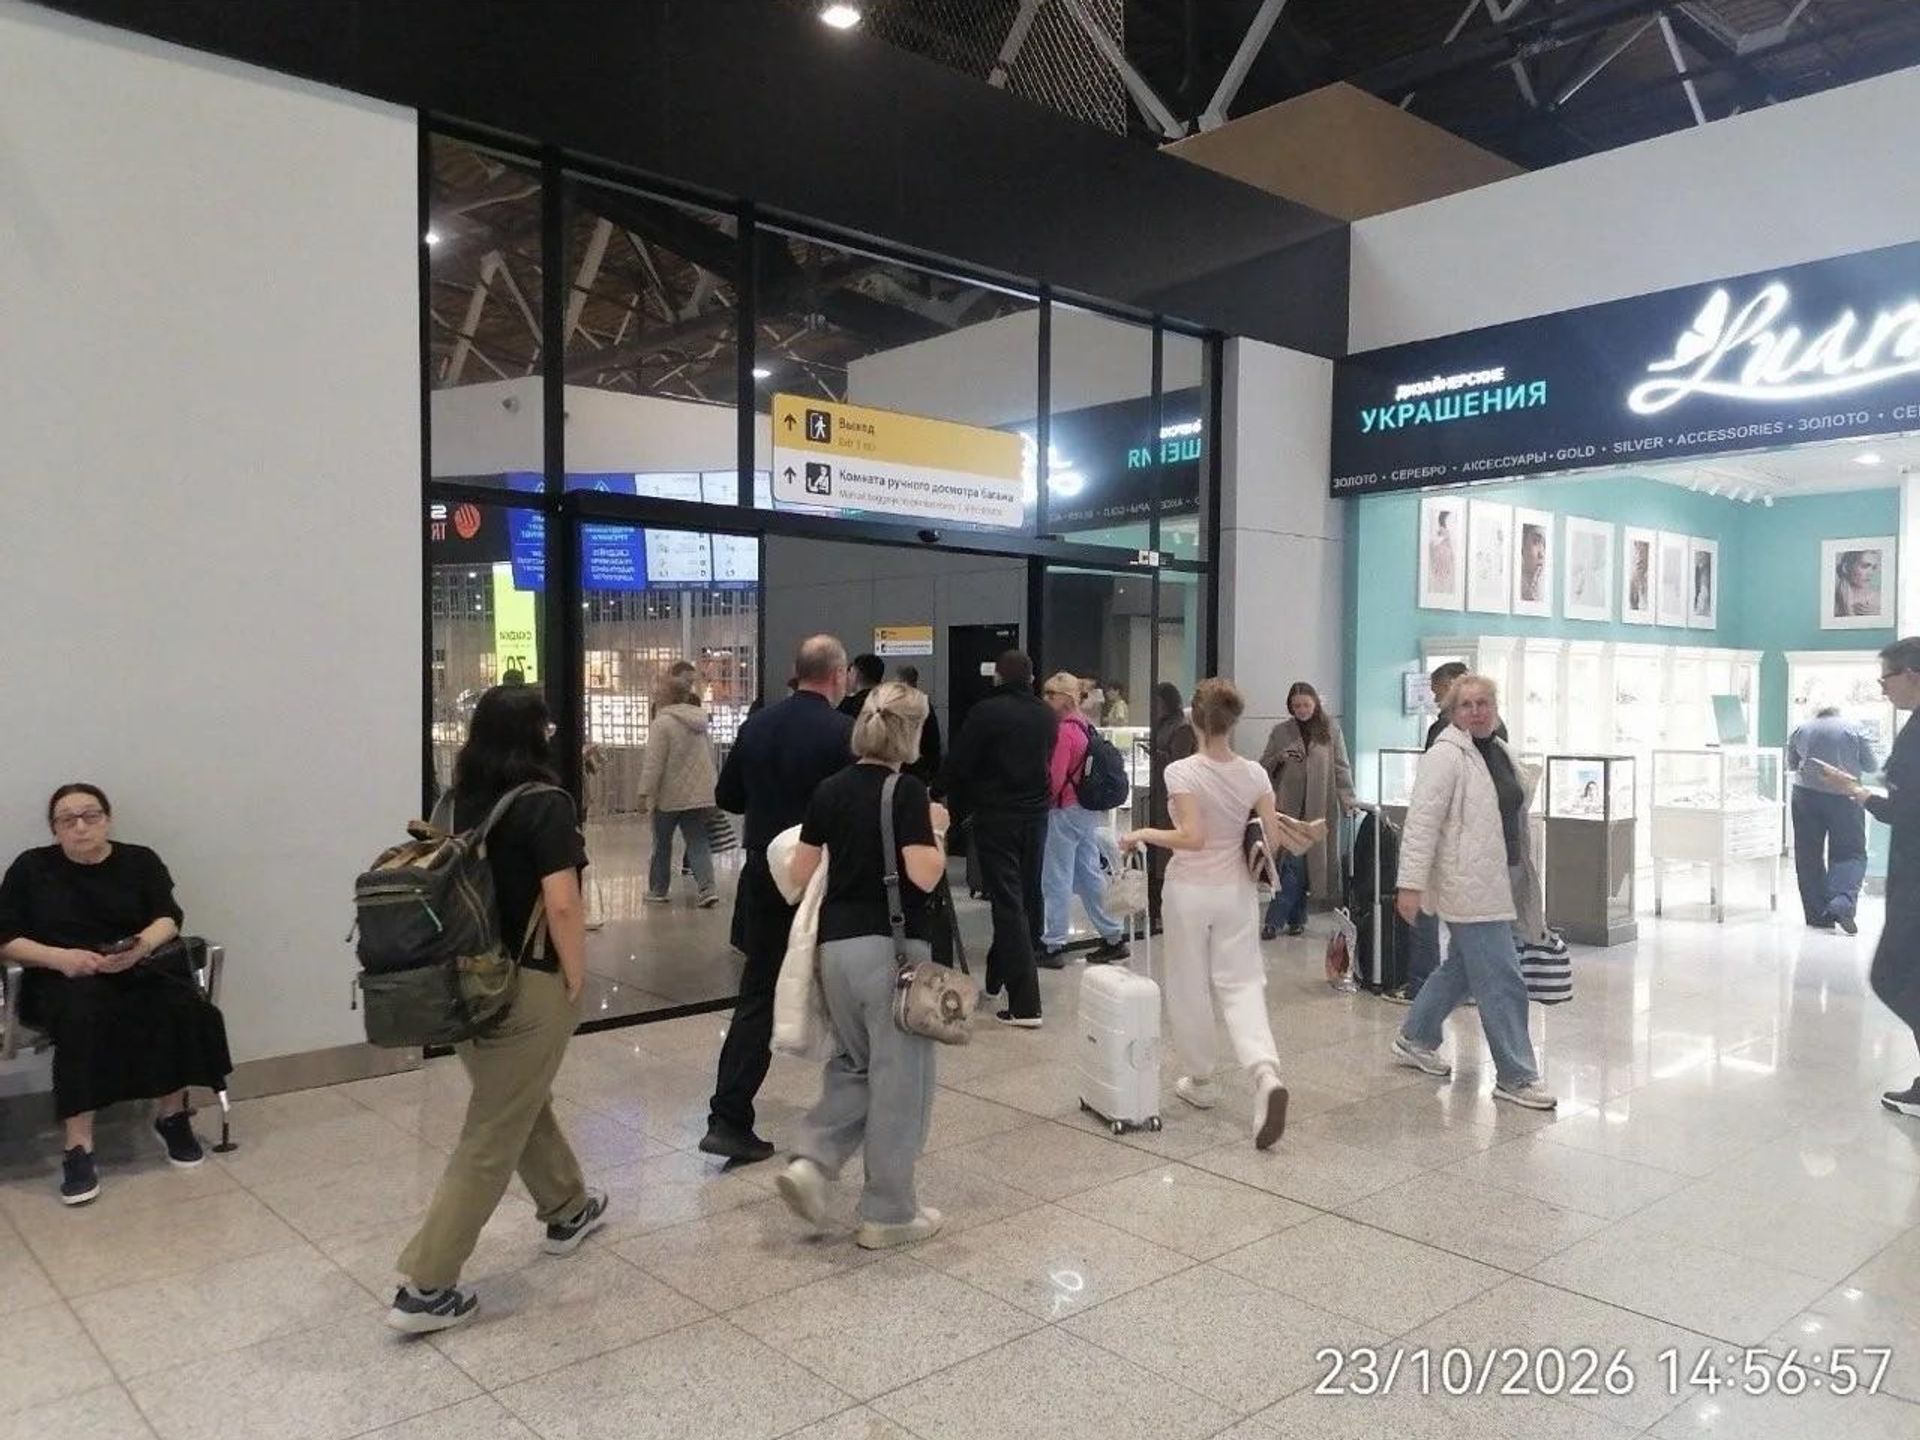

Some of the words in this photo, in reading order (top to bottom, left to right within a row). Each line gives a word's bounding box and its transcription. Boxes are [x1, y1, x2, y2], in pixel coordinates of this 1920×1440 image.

[838, 417, 875, 435] Выход
[1361, 380, 1547, 433] УКРАШЕНИЯ
[1333, 473, 1377, 488] ЗОЛОТО
[1391, 465, 1447, 481] СЕРЕБРО
[1462, 451, 1547, 472] АКСЕССУАРЫ
[1556, 445, 1596, 461] GOLD
[1613, 436, 1664, 454] SILVER
[1677, 421, 1784, 446] ACCESSORIES
[1797, 411, 1870, 432] ЗОЛОТО
[1893, 404, 1920, 420] СЕ
[839, 470, 885, 486] Комната
[888, 477, 930, 491] ручного
[932, 484, 979, 499] досмотра
